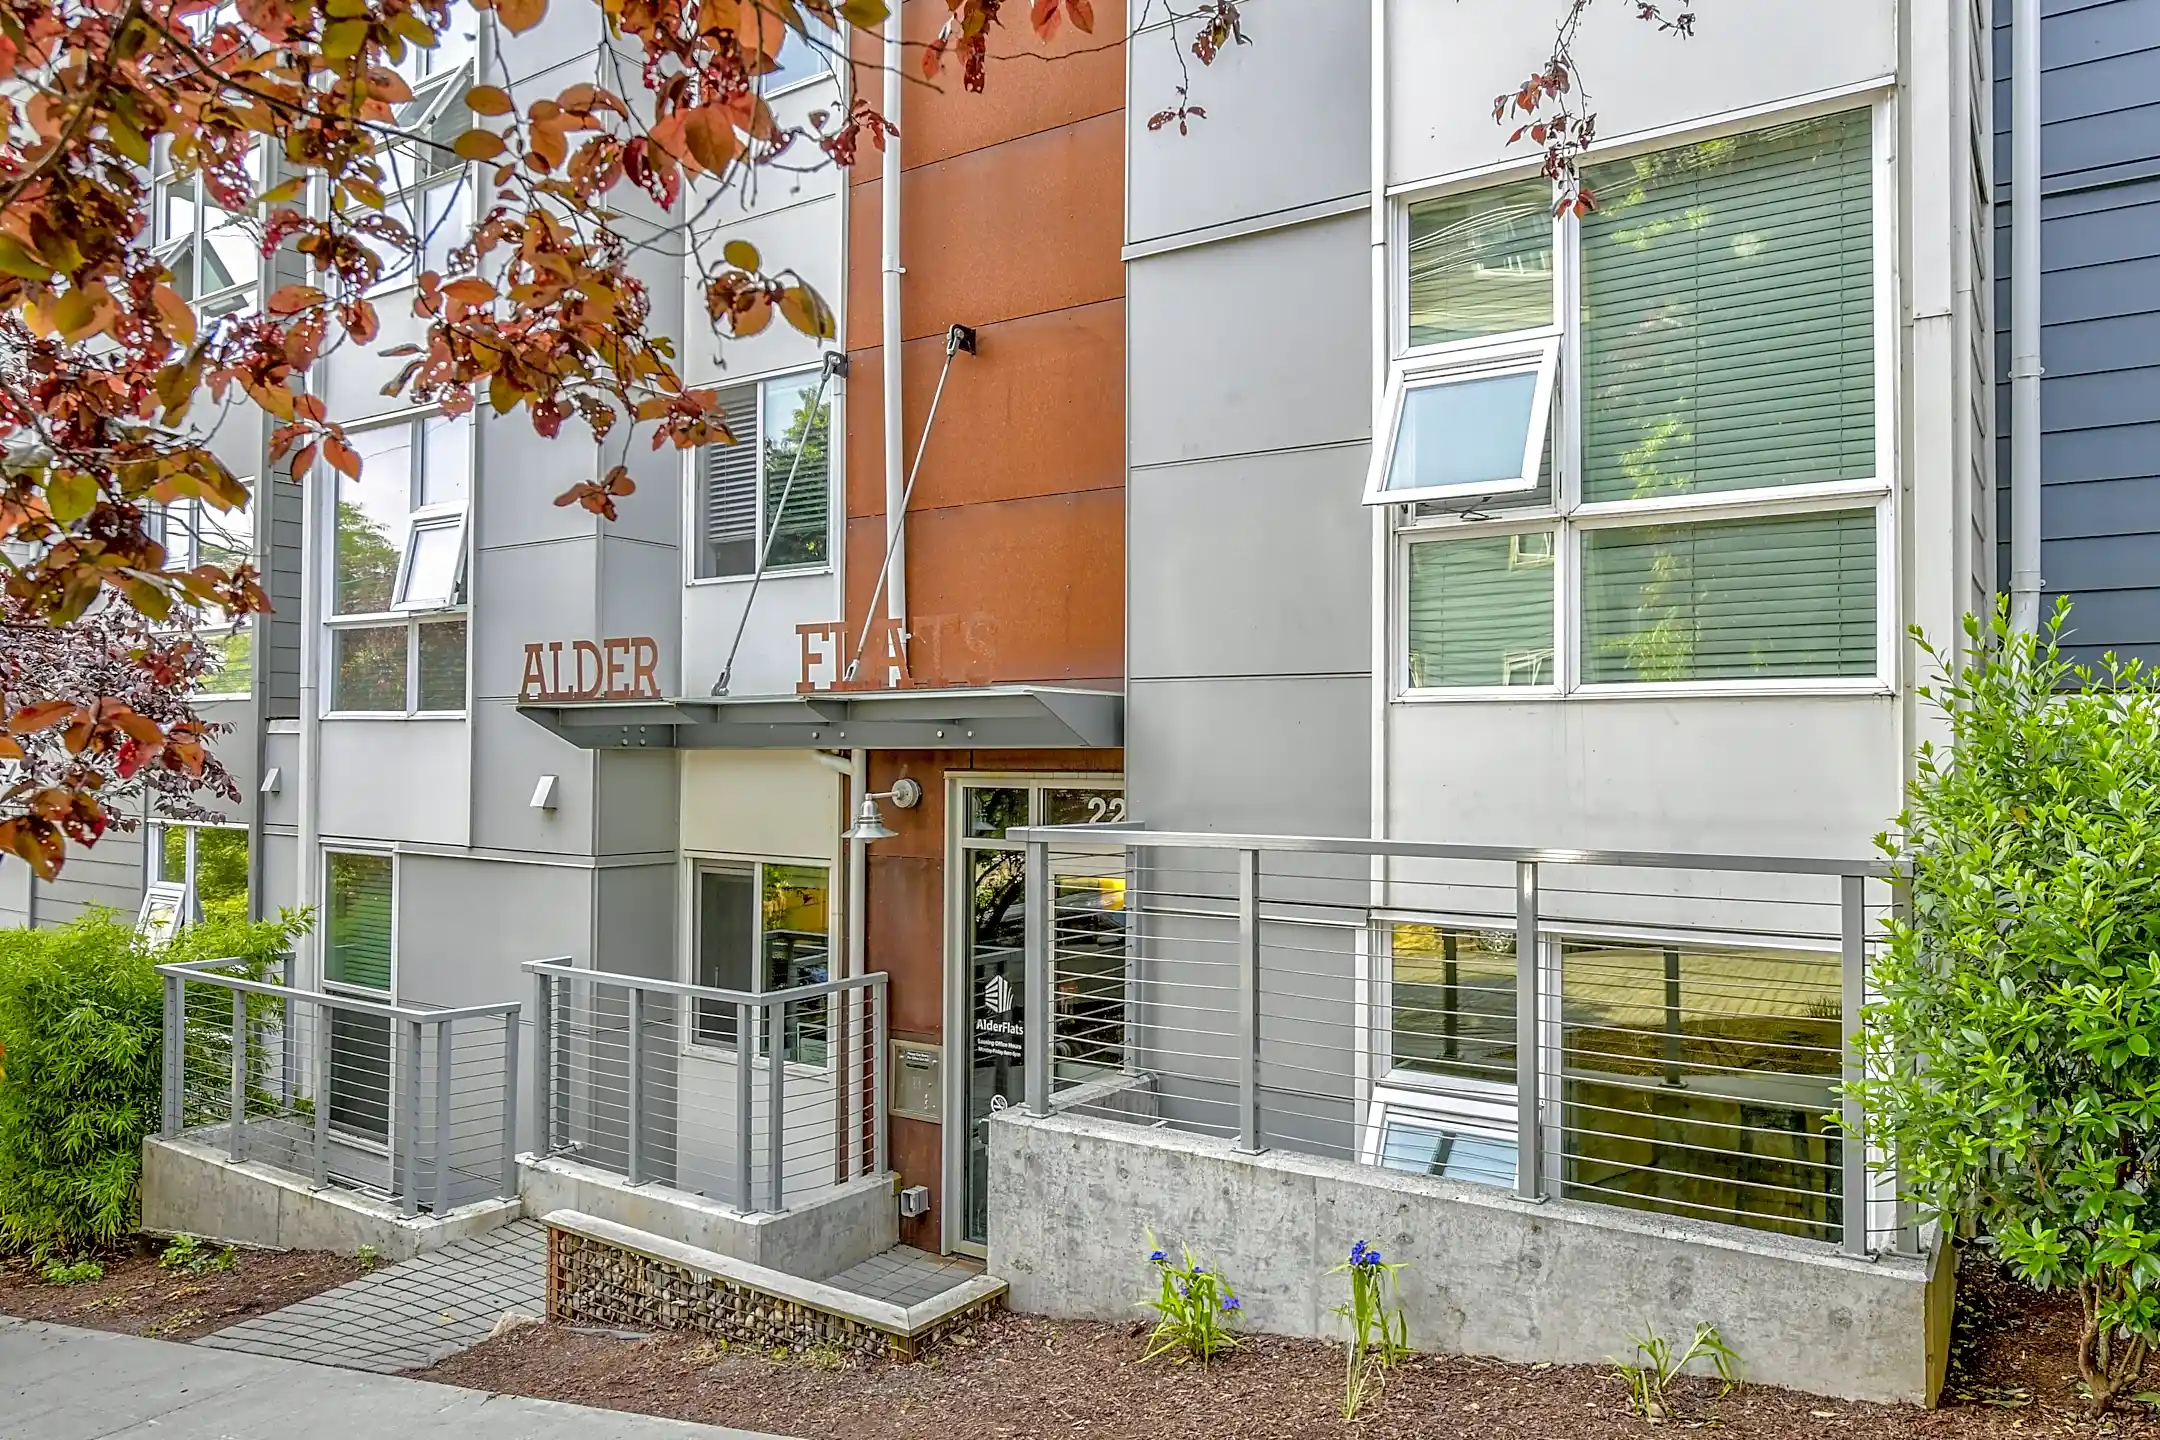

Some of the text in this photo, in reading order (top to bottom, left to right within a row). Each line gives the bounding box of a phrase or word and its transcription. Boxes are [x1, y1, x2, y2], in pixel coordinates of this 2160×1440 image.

[518, 612, 998, 700] ALDER FLATS
[975, 1018, 1024, 1035] AlderFlats
